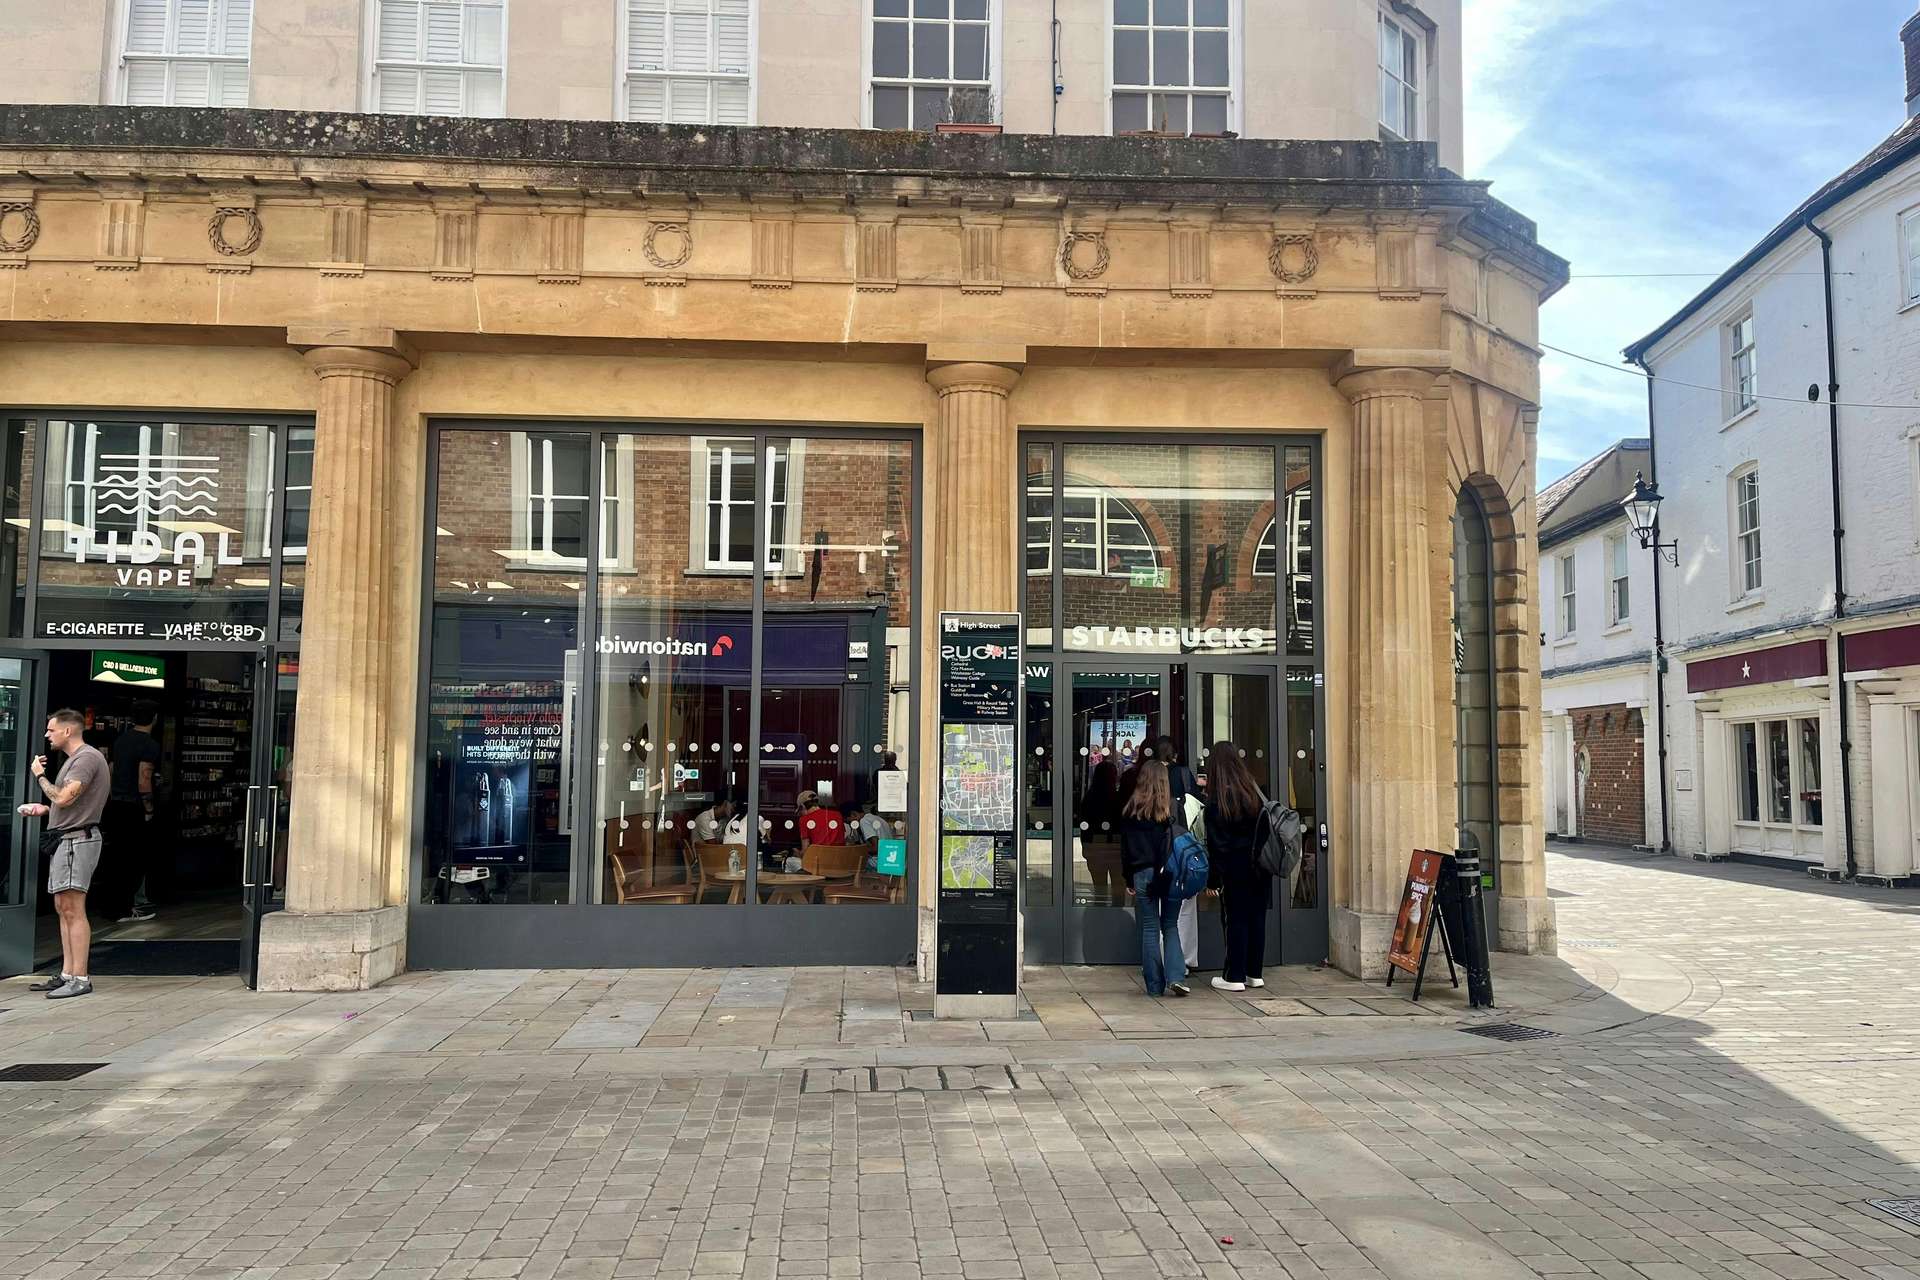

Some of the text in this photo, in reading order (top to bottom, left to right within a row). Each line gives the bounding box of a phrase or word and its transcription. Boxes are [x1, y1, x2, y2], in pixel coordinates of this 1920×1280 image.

[69, 530, 243, 565] TIDAL
[117, 568, 192, 587] VAPE
[46, 621, 145, 636] E-CIGARETTE
[164, 623, 203, 637] VAPE
[222, 624, 254, 637] CBD
[960, 621, 1001, 630] High Street
[1071, 626, 1264, 649] STARBUCKS
